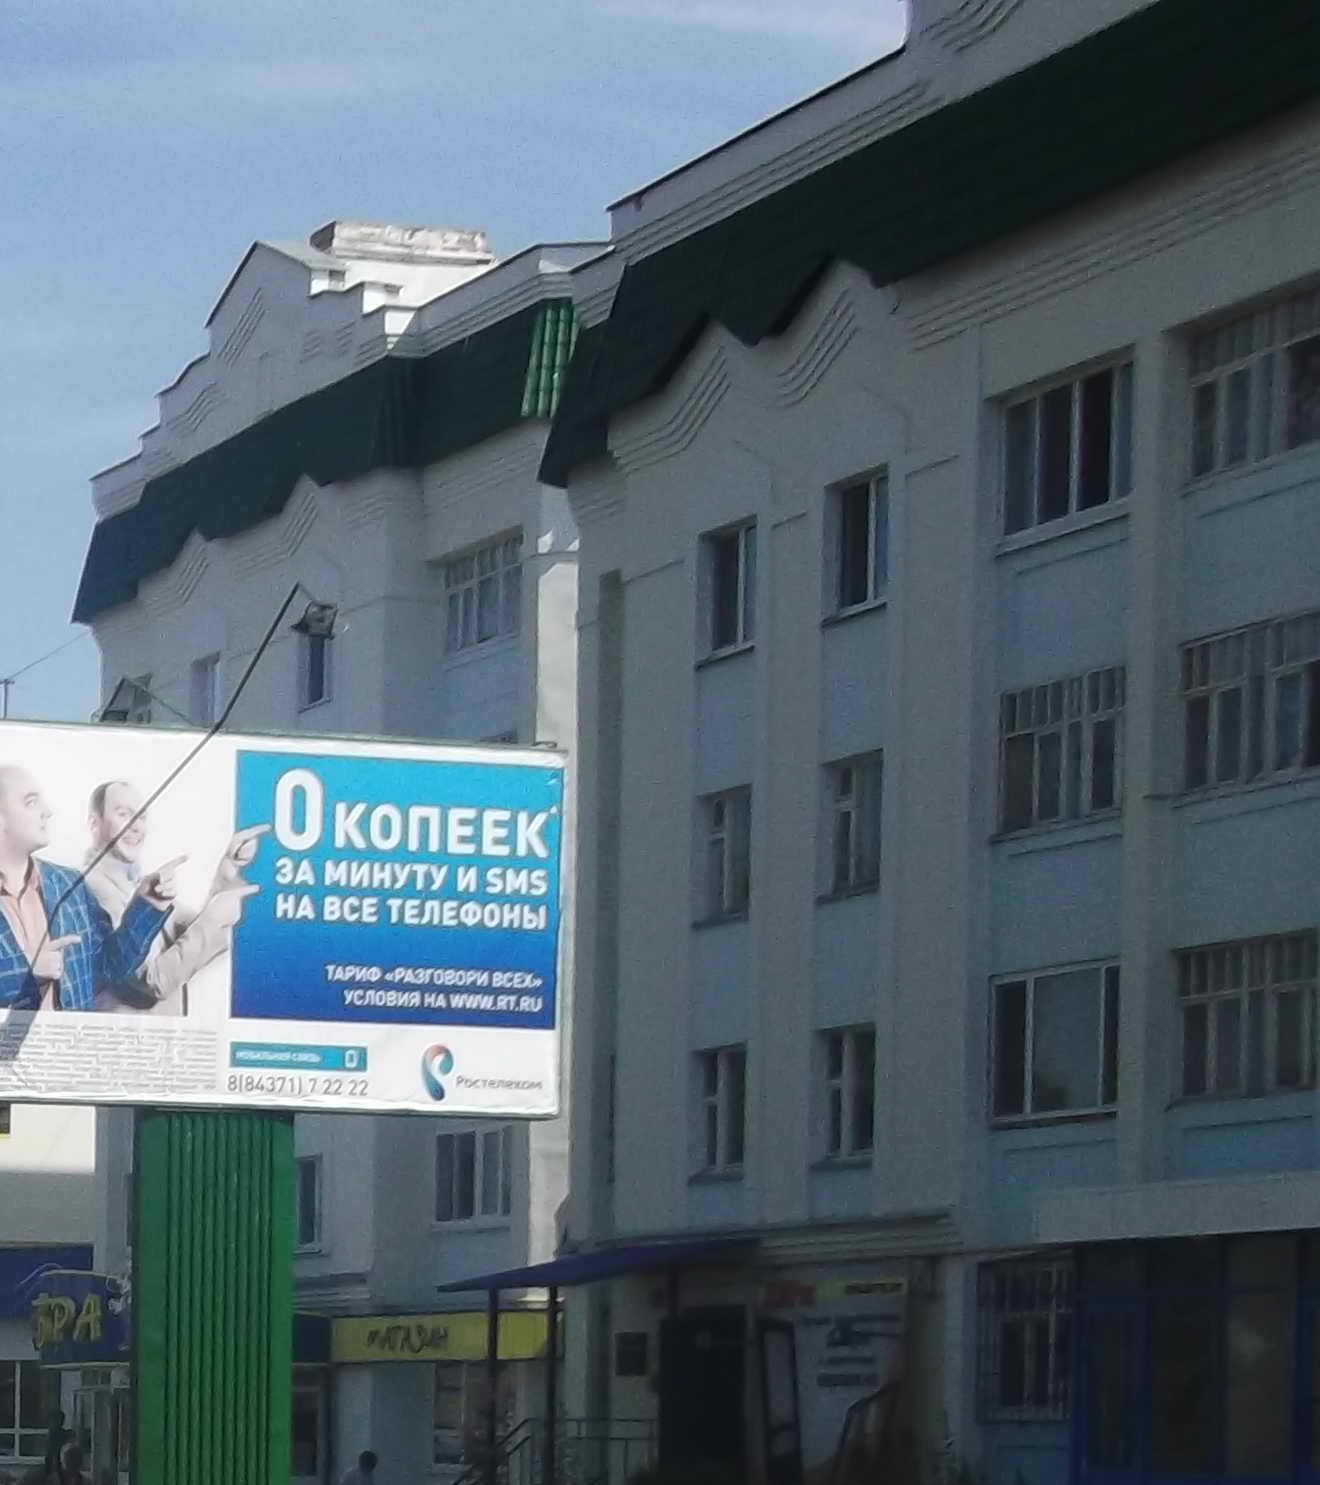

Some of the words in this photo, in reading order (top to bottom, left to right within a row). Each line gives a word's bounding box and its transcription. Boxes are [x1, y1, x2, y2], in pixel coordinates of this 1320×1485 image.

[275, 768, 323, 851] 0
[334, 802, 552, 858] КОПЕЕК
[275, 856, 315, 886] ЗА
[324, 859, 448, 892] МИНУТУ
[456, 866, 477, 893] И
[486, 867, 548, 897] SMS
[275, 893, 315, 920] НА
[323, 895, 378, 923] ВСЕ
[386, 897, 547, 930] ТЕЛЕФОНЫ
[325, 964, 382, 982] ТАРИФ
[384, 967, 489, 987] «РАЗГОВОРИ
[492, 969, 544, 988] ВСЕХ»
[343, 989, 421, 1008] УСЛОВИЯ
[424, 992, 446, 1009] НА
[449, 993, 544, 1013] WWW.RT.RU
[227, 1074, 303, 1095] 8(84371)
[309, 1078, 318, 1094] 7
[323, 1079, 343, 1095] 22
[348, 1080, 369, 1096] 22
[456, 1075, 544, 1091] Ростелеком
